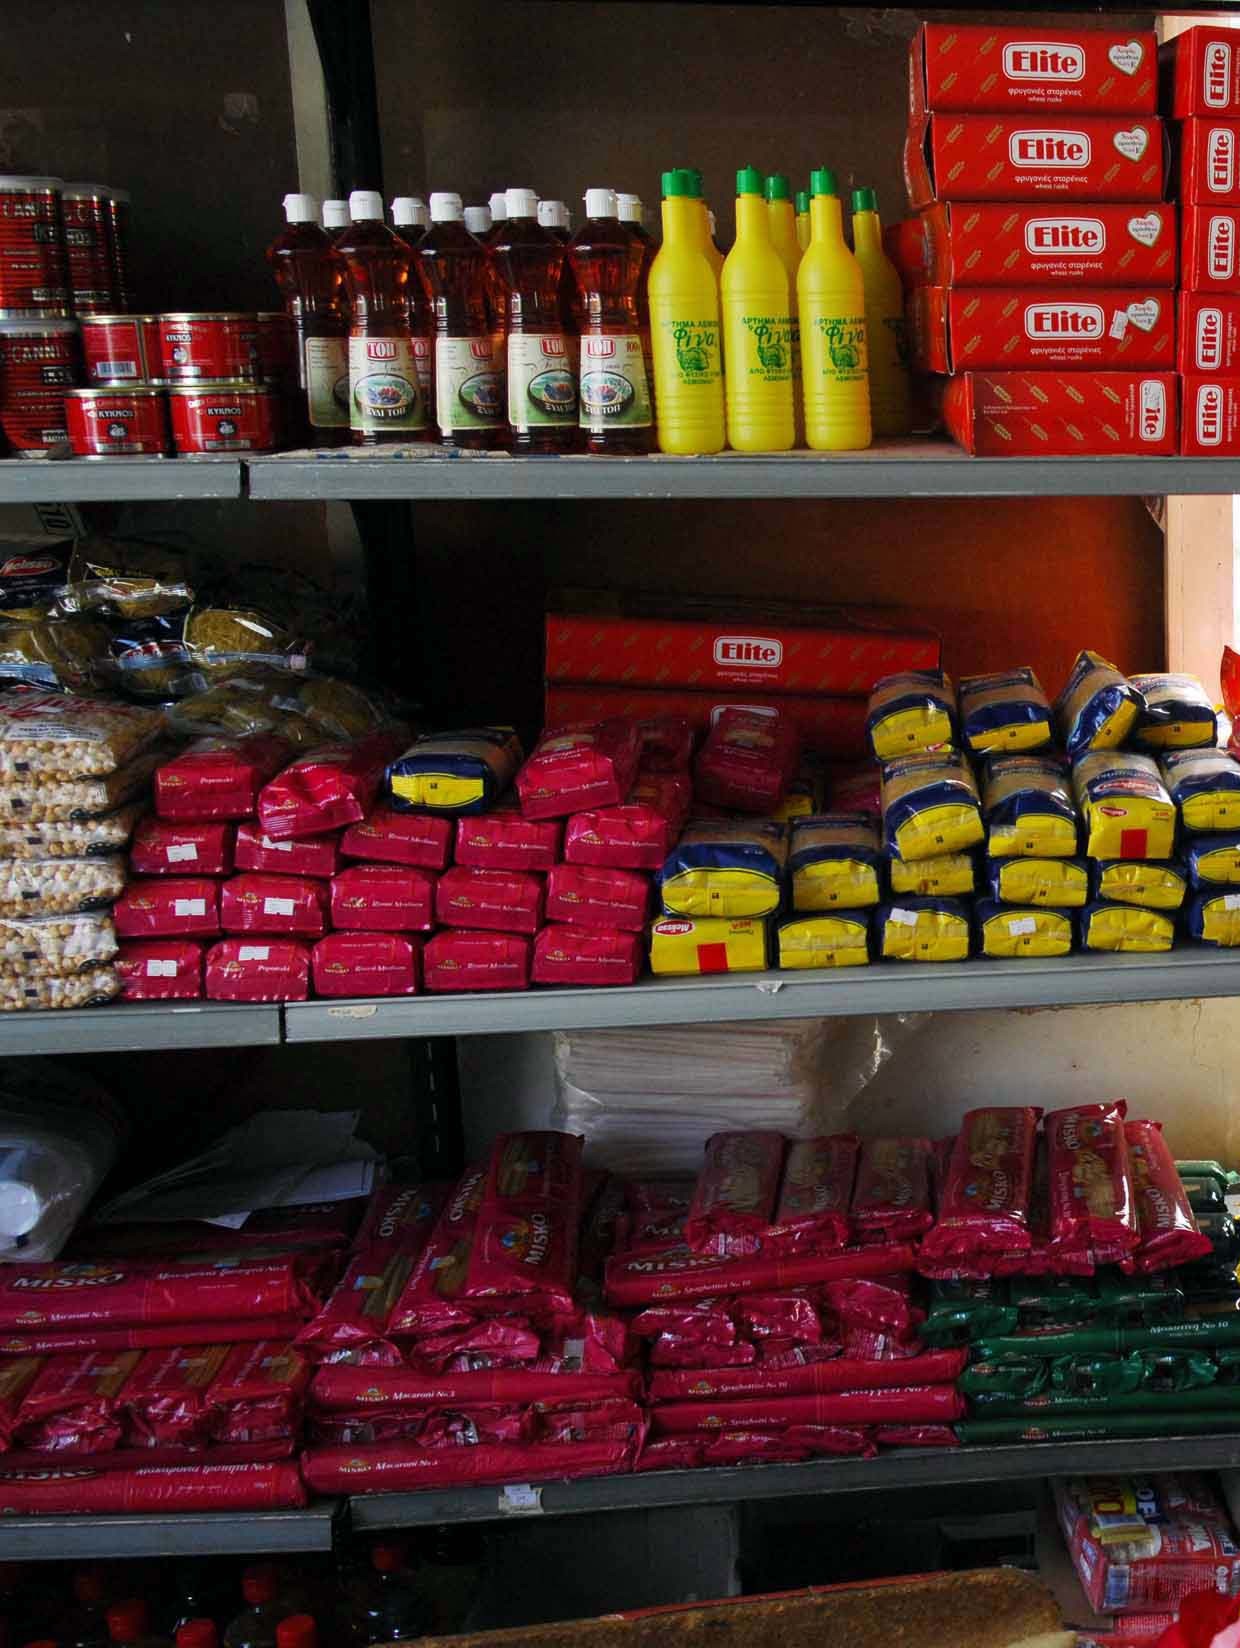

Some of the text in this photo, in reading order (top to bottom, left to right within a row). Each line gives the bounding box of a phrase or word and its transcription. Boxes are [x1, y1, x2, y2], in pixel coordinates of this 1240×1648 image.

[1011, 50, 1078, 75] Elite
[1209, 48, 1226, 101] Elite
[1018, 138, 1084, 161] Elite
[1213, 134, 1230, 185] Elite
[1034, 225, 1099, 248] Elite
[1213, 222, 1230, 272] Elite
[1033, 311, 1098, 334] Elite
[1201, 314, 1218, 363] Elite
[1202, 391, 1218, 439] Elite
[721, 643, 777, 663] Elite
[989, 1169, 1014, 1211] MISKO
[524, 1213, 550, 1266] MISKO
[13, 1272, 126, 1290] MISKO
